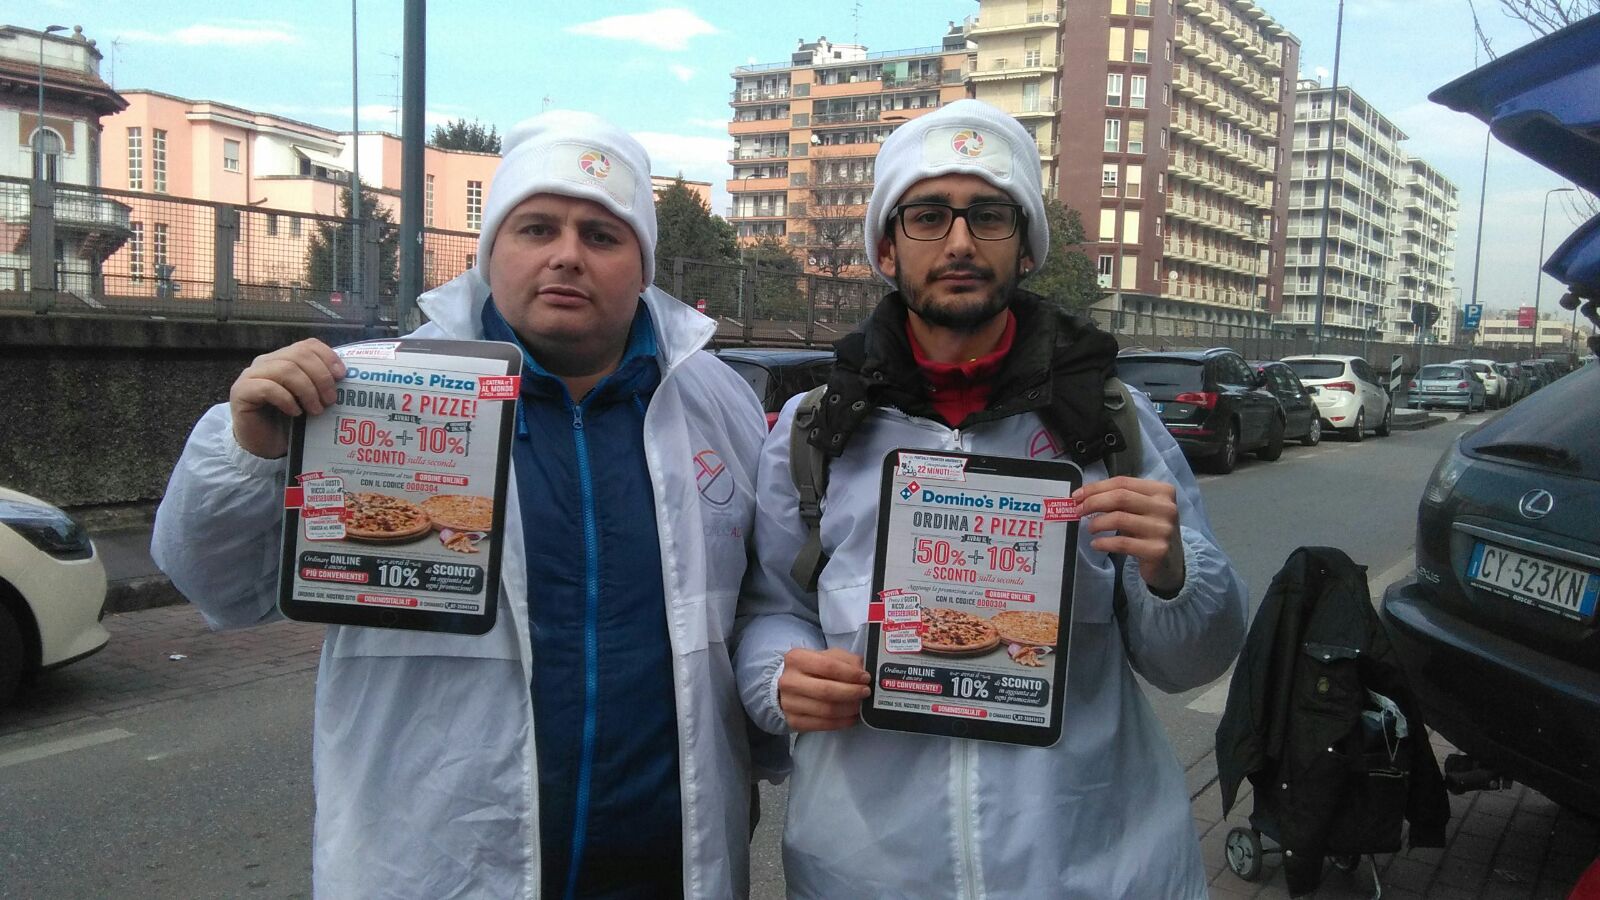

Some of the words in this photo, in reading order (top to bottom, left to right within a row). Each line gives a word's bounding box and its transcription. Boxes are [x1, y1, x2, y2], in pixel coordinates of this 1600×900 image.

[1468, 305, 1479, 316] P
[345, 367, 424, 386] Domino's
[429, 375, 475, 391] Pizza
[336, 388, 396, 410] ORDINA
[402, 394, 411, 412] 2
[419, 396, 478, 418] PIZZE!
[339, 418, 394, 447] 50%
[416, 426, 464, 454] 10%
[357, 448, 405, 465] SCONTO
[407, 456, 424, 464] sulla
[427, 459, 456, 467] seconda
[917, 465, 926, 473] 22
[927, 467, 950, 475] MINUTI
[382, 481, 405, 489] CODICE
[922, 490, 994, 509] Domino's
[999, 497, 1041, 513] Pizza
[913, 512, 969, 532] ORDINA
[974, 516, 984, 533] 2
[990, 518, 1044, 538] PIZZE!
[304, 555, 330, 564] Ordinare
[330, 555, 361, 565] ONLINE
[917, 538, 967, 566] 50%
[987, 546, 1031, 573] 10%
[318, 570, 365, 581] CONVENIENTE!
[378, 564, 420, 587] 10%
[432, 564, 476, 578] SCONTO
[932, 567, 976, 584] SCONTO
[978, 574, 995, 582] sulla
[997, 577, 1025, 585] seconda
[438, 583, 474, 592] promozione!
[955, 597, 976, 605] CODICE
[989, 591, 1010, 599] ORDINE
[1010, 593, 1031, 601] ONLINE
[907, 667, 936, 677] ONLINE
[896, 681, 939, 691] CONVENIENTE!
[951, 676, 989, 698] 10%
[1001, 676, 1042, 691] SCONTO
[1005, 689, 1029, 697] aggiunta
[1007, 696, 1041, 704] promozione!
